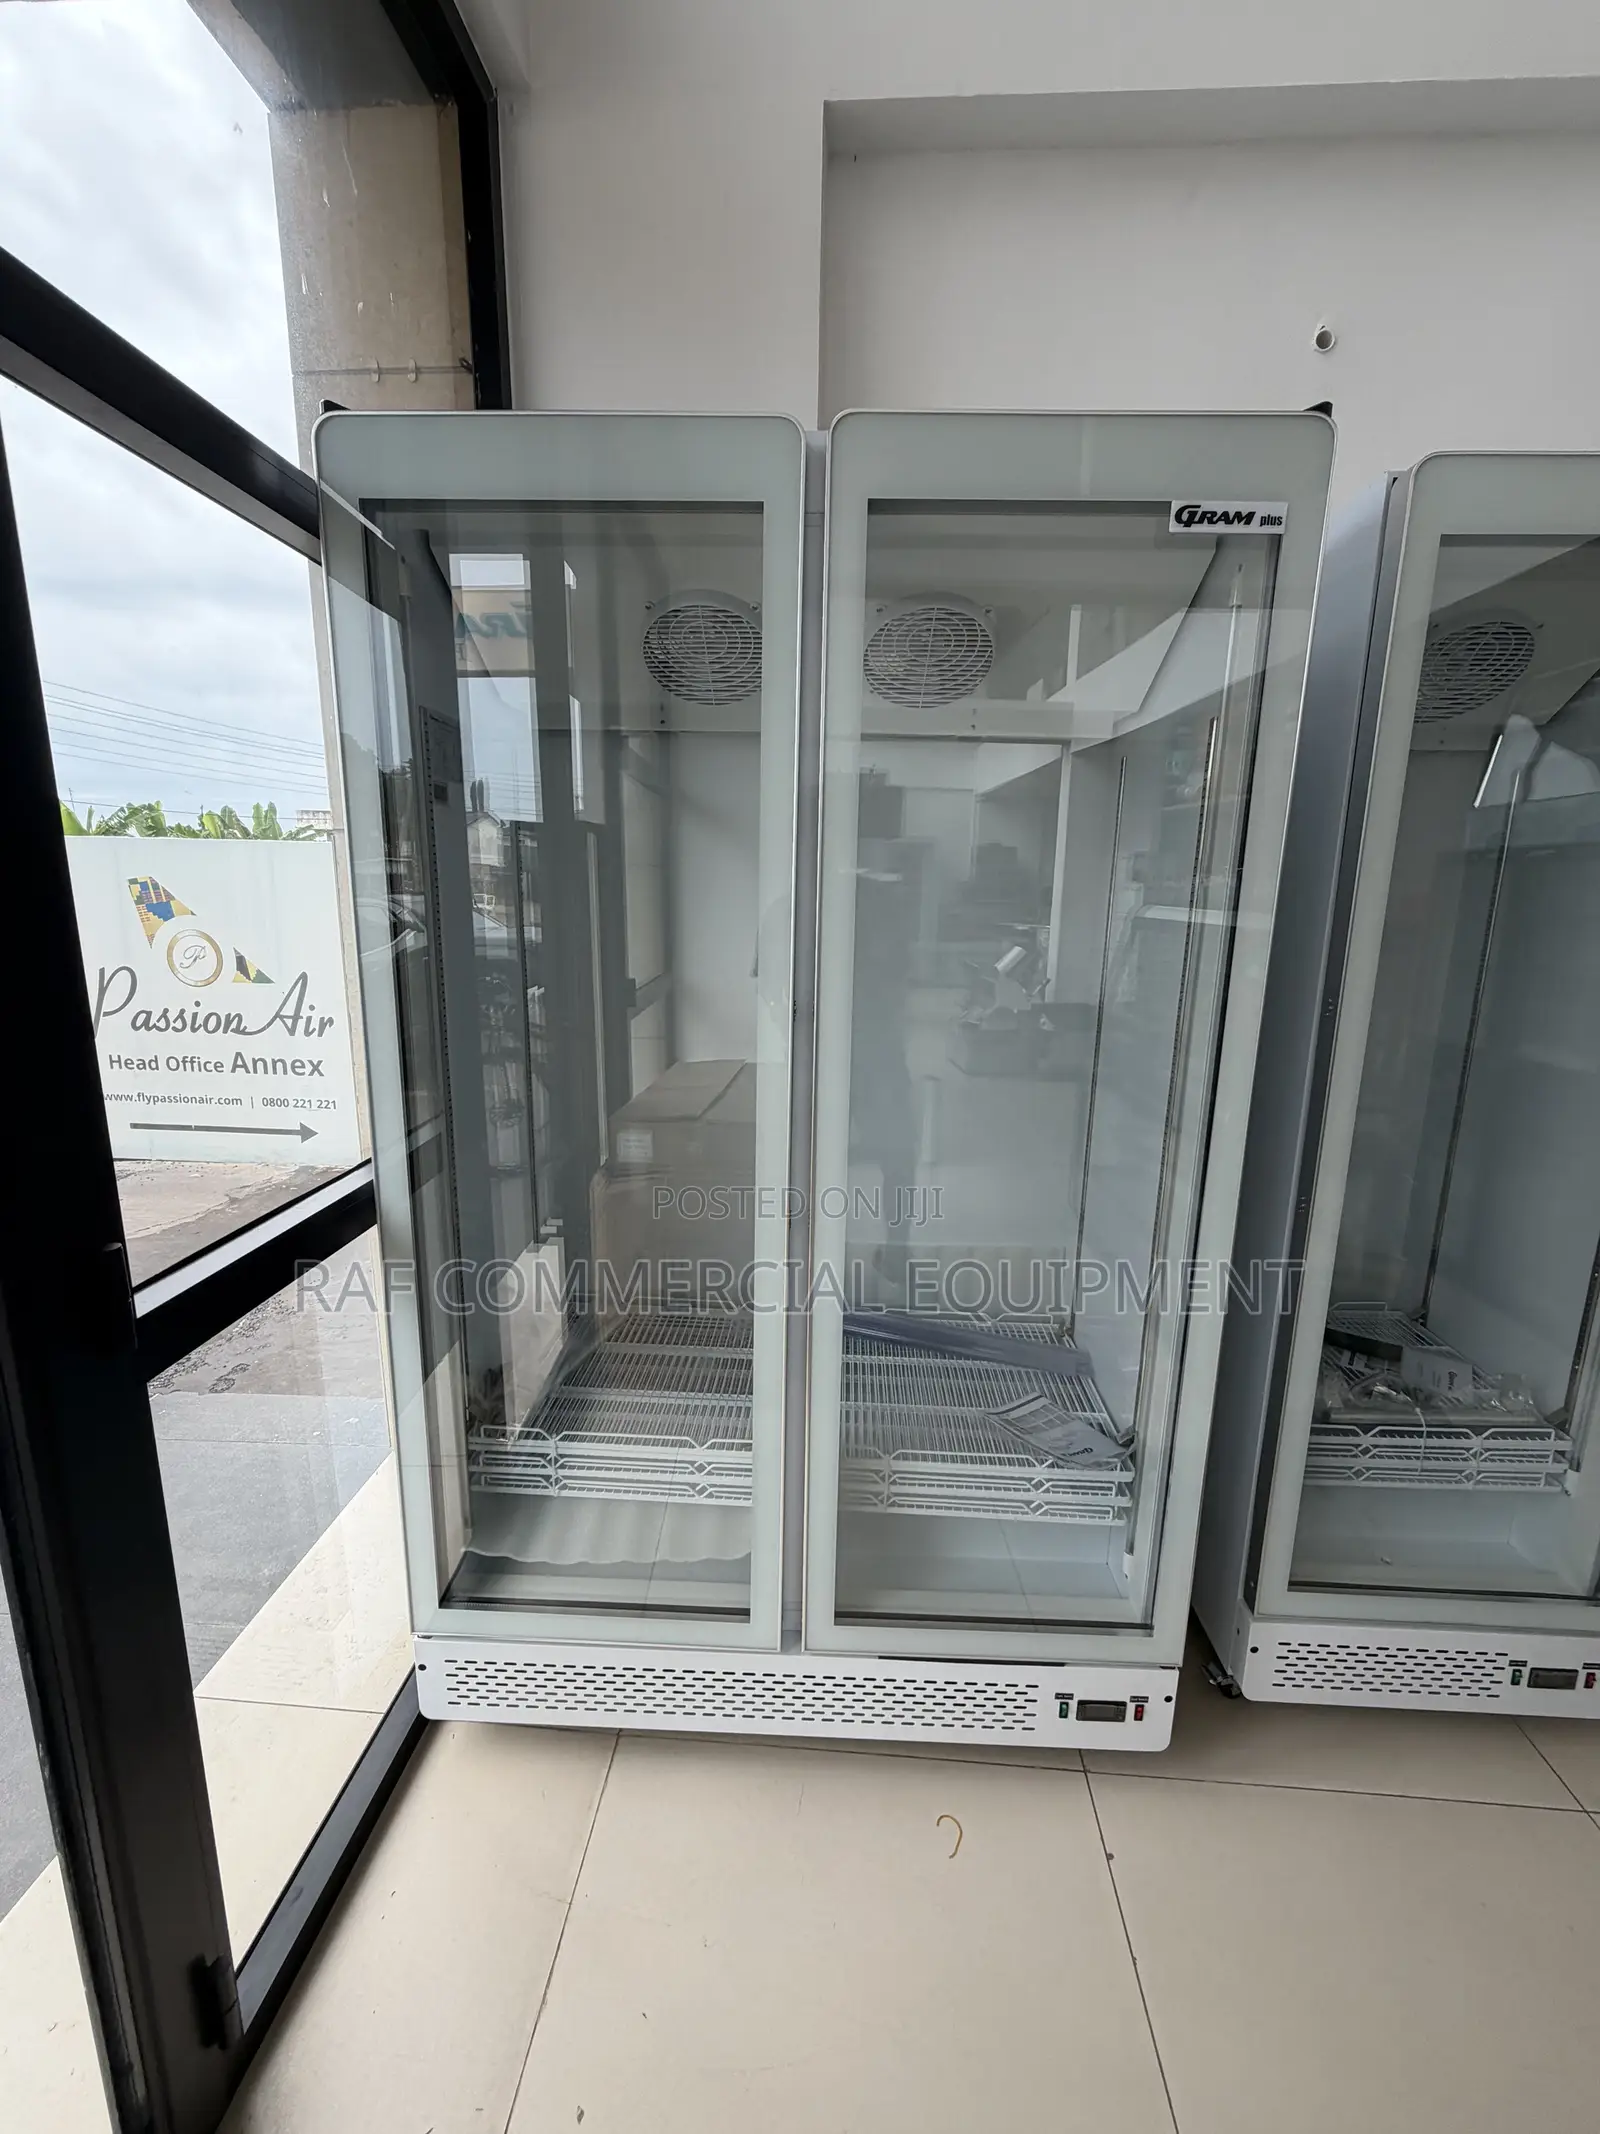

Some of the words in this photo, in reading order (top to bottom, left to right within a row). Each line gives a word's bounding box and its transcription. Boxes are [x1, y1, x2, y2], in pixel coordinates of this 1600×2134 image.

[1174, 504, 1256, 527] GRAM
[1260, 514, 1283, 527] plus
[94, 965, 248, 1039] Passion
[256, 971, 334, 1038] Air
[108, 1054, 160, 1072] Head
[166, 1055, 225, 1074] Office
[230, 1051, 325, 1077] Annex
[103, 1091, 243, 1107] www.flypassionair.com
[261, 1097, 290, 1109] 0800
[292, 1098, 313, 1110] 221
[316, 1099, 337, 1111] 221
